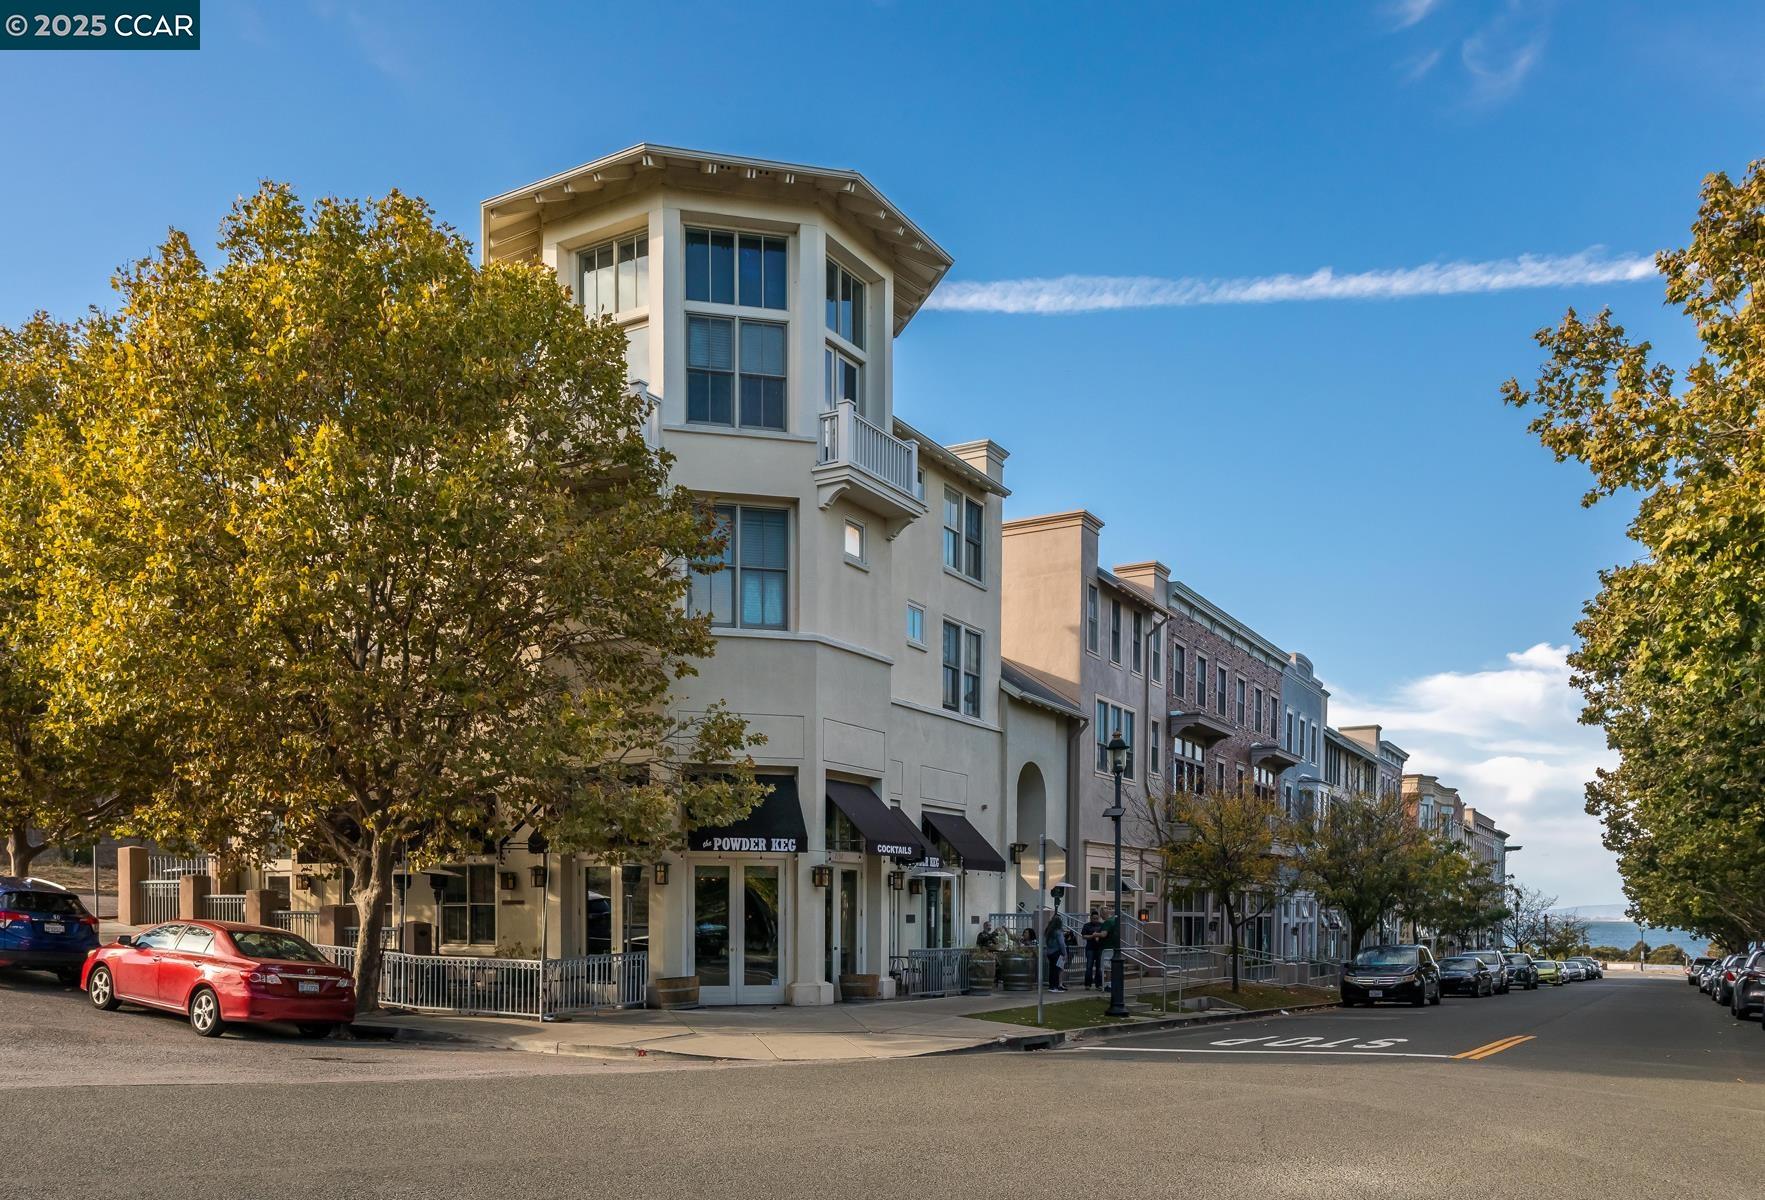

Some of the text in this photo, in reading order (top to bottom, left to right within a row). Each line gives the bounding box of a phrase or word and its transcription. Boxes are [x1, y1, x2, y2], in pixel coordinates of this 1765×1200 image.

[702, 837, 797, 851] the POWDER KEG
[877, 844, 912, 855] COCKTAILS
[1209, 1035, 1409, 1049] STOP
